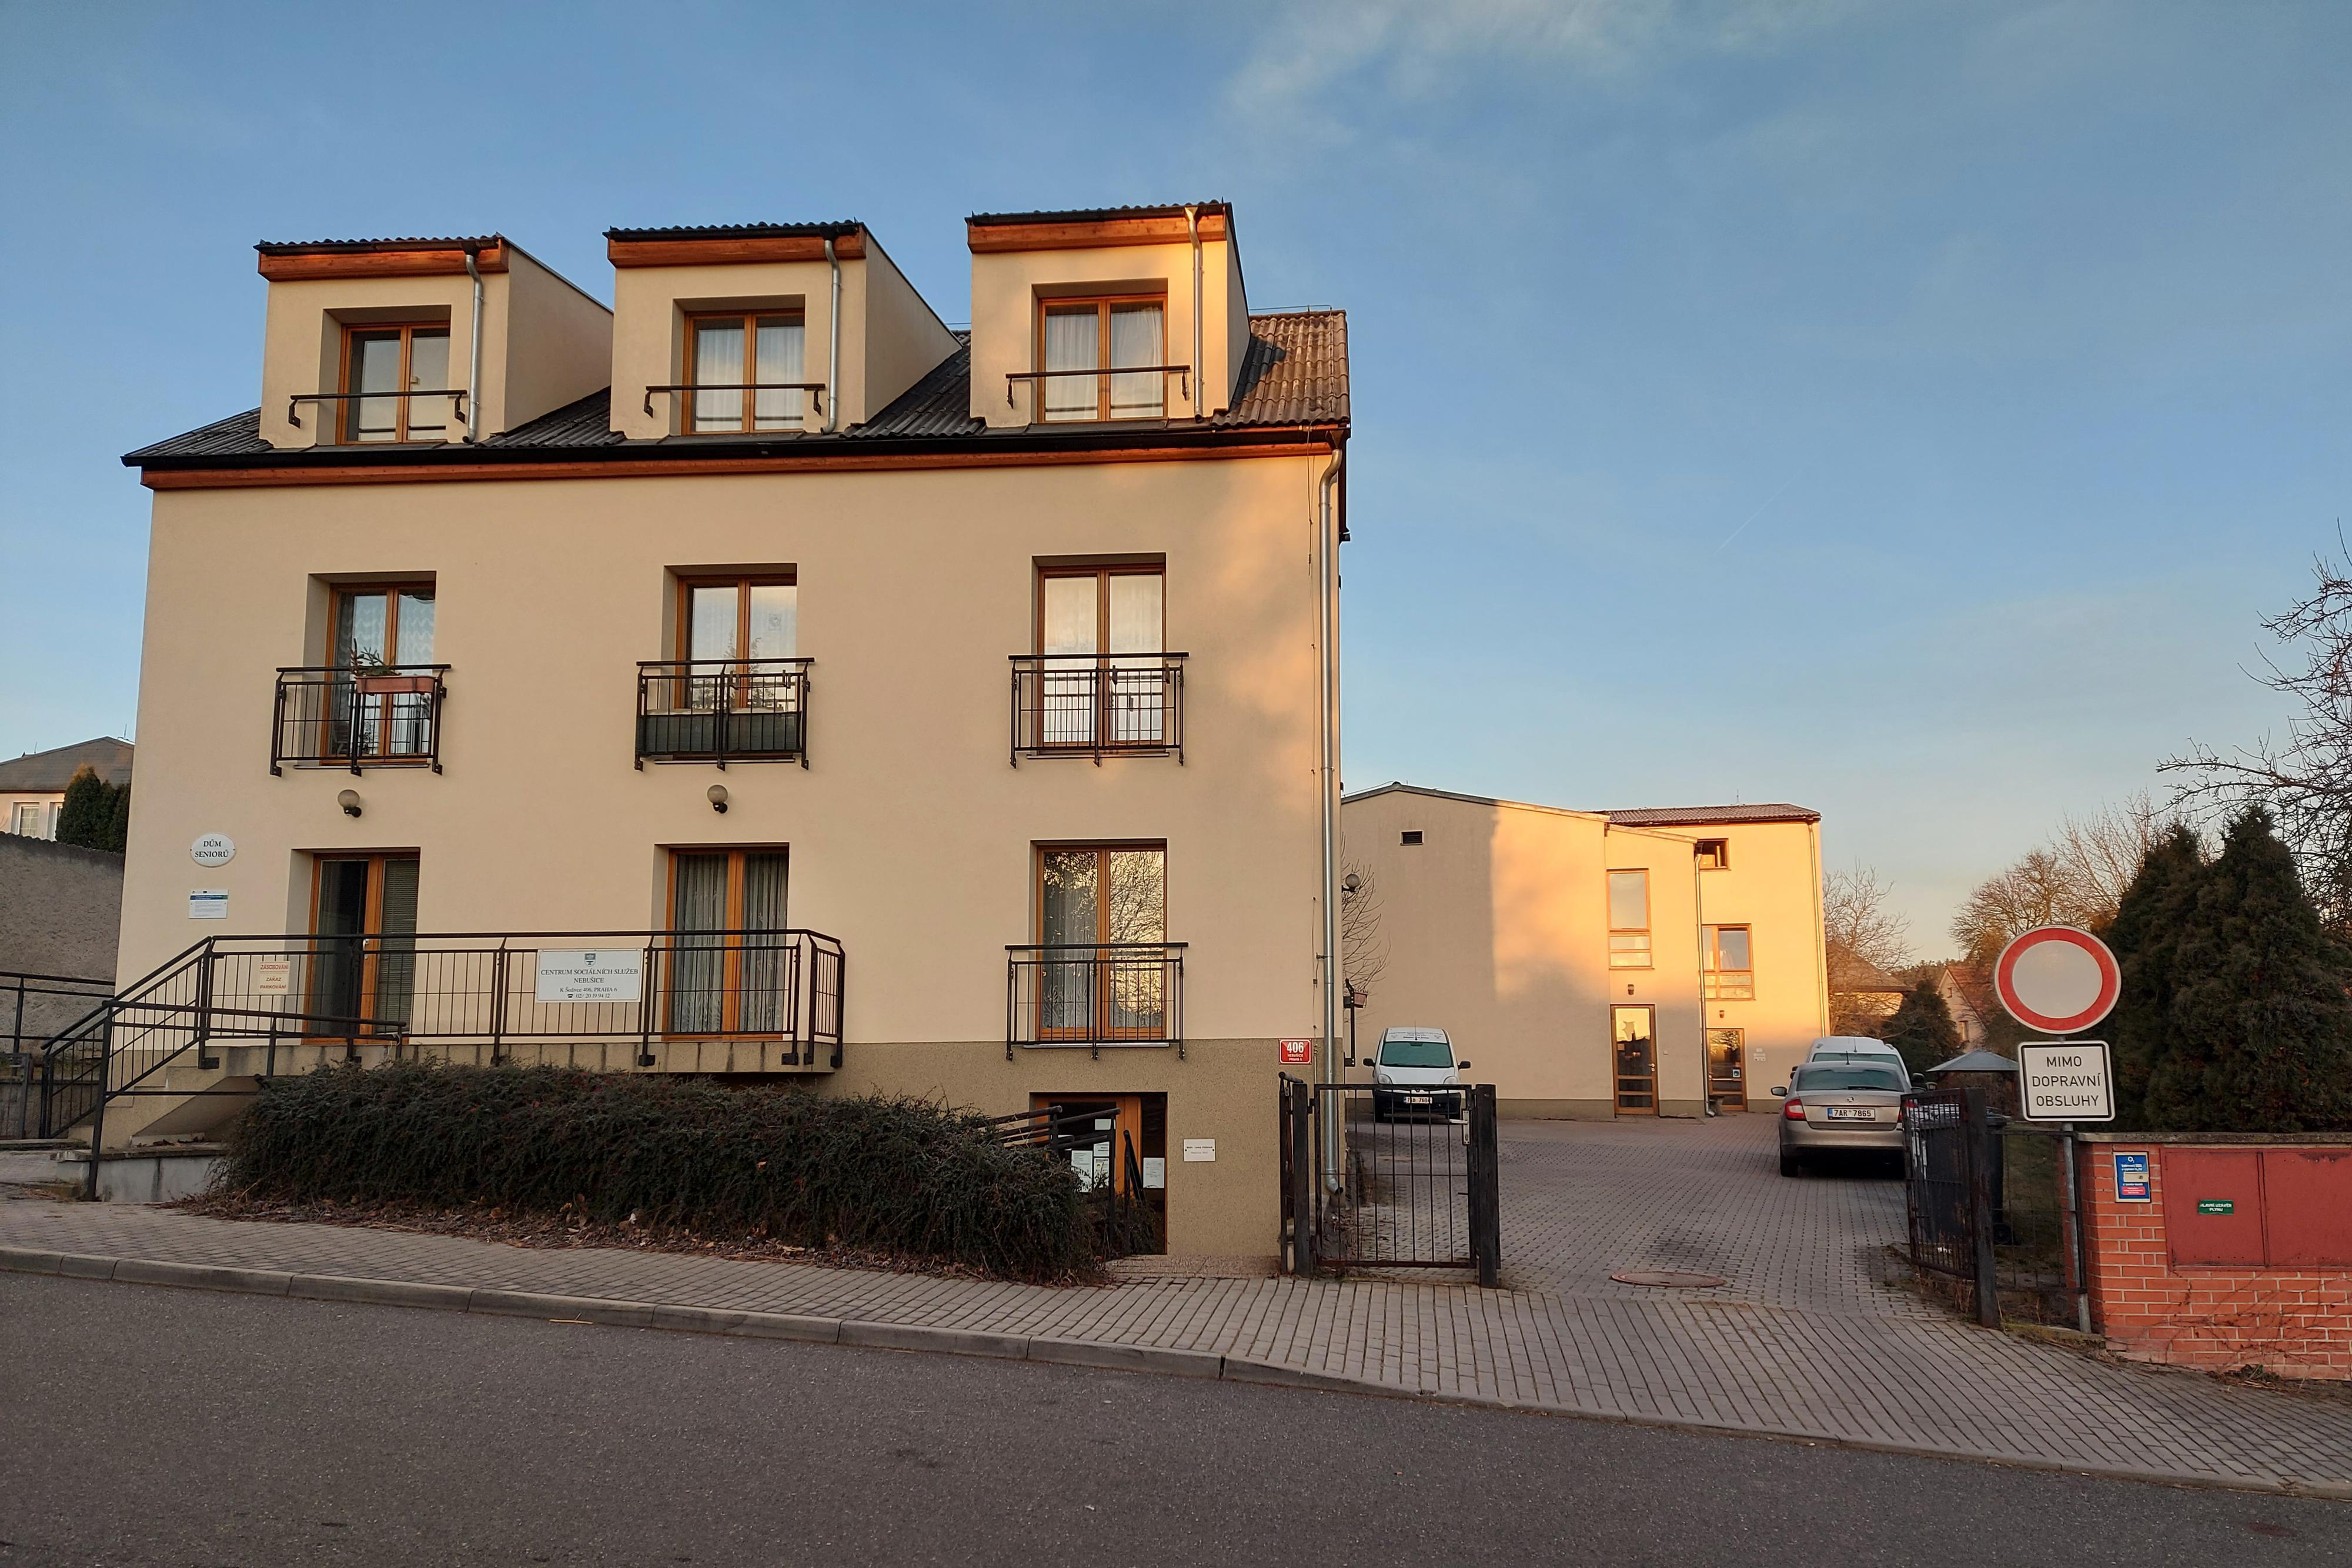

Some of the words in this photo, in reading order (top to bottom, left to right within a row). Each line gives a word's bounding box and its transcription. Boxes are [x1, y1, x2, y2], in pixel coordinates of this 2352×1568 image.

[195, 849, 229, 857] SENIORŮ
[1287, 1042, 1304, 1053] 406
[2046, 1056, 2082, 1067] MIMO
[2032, 1072, 2101, 1086] DOPRAVNÍ
[2036, 1095, 2099, 1106] OBSLUHY
